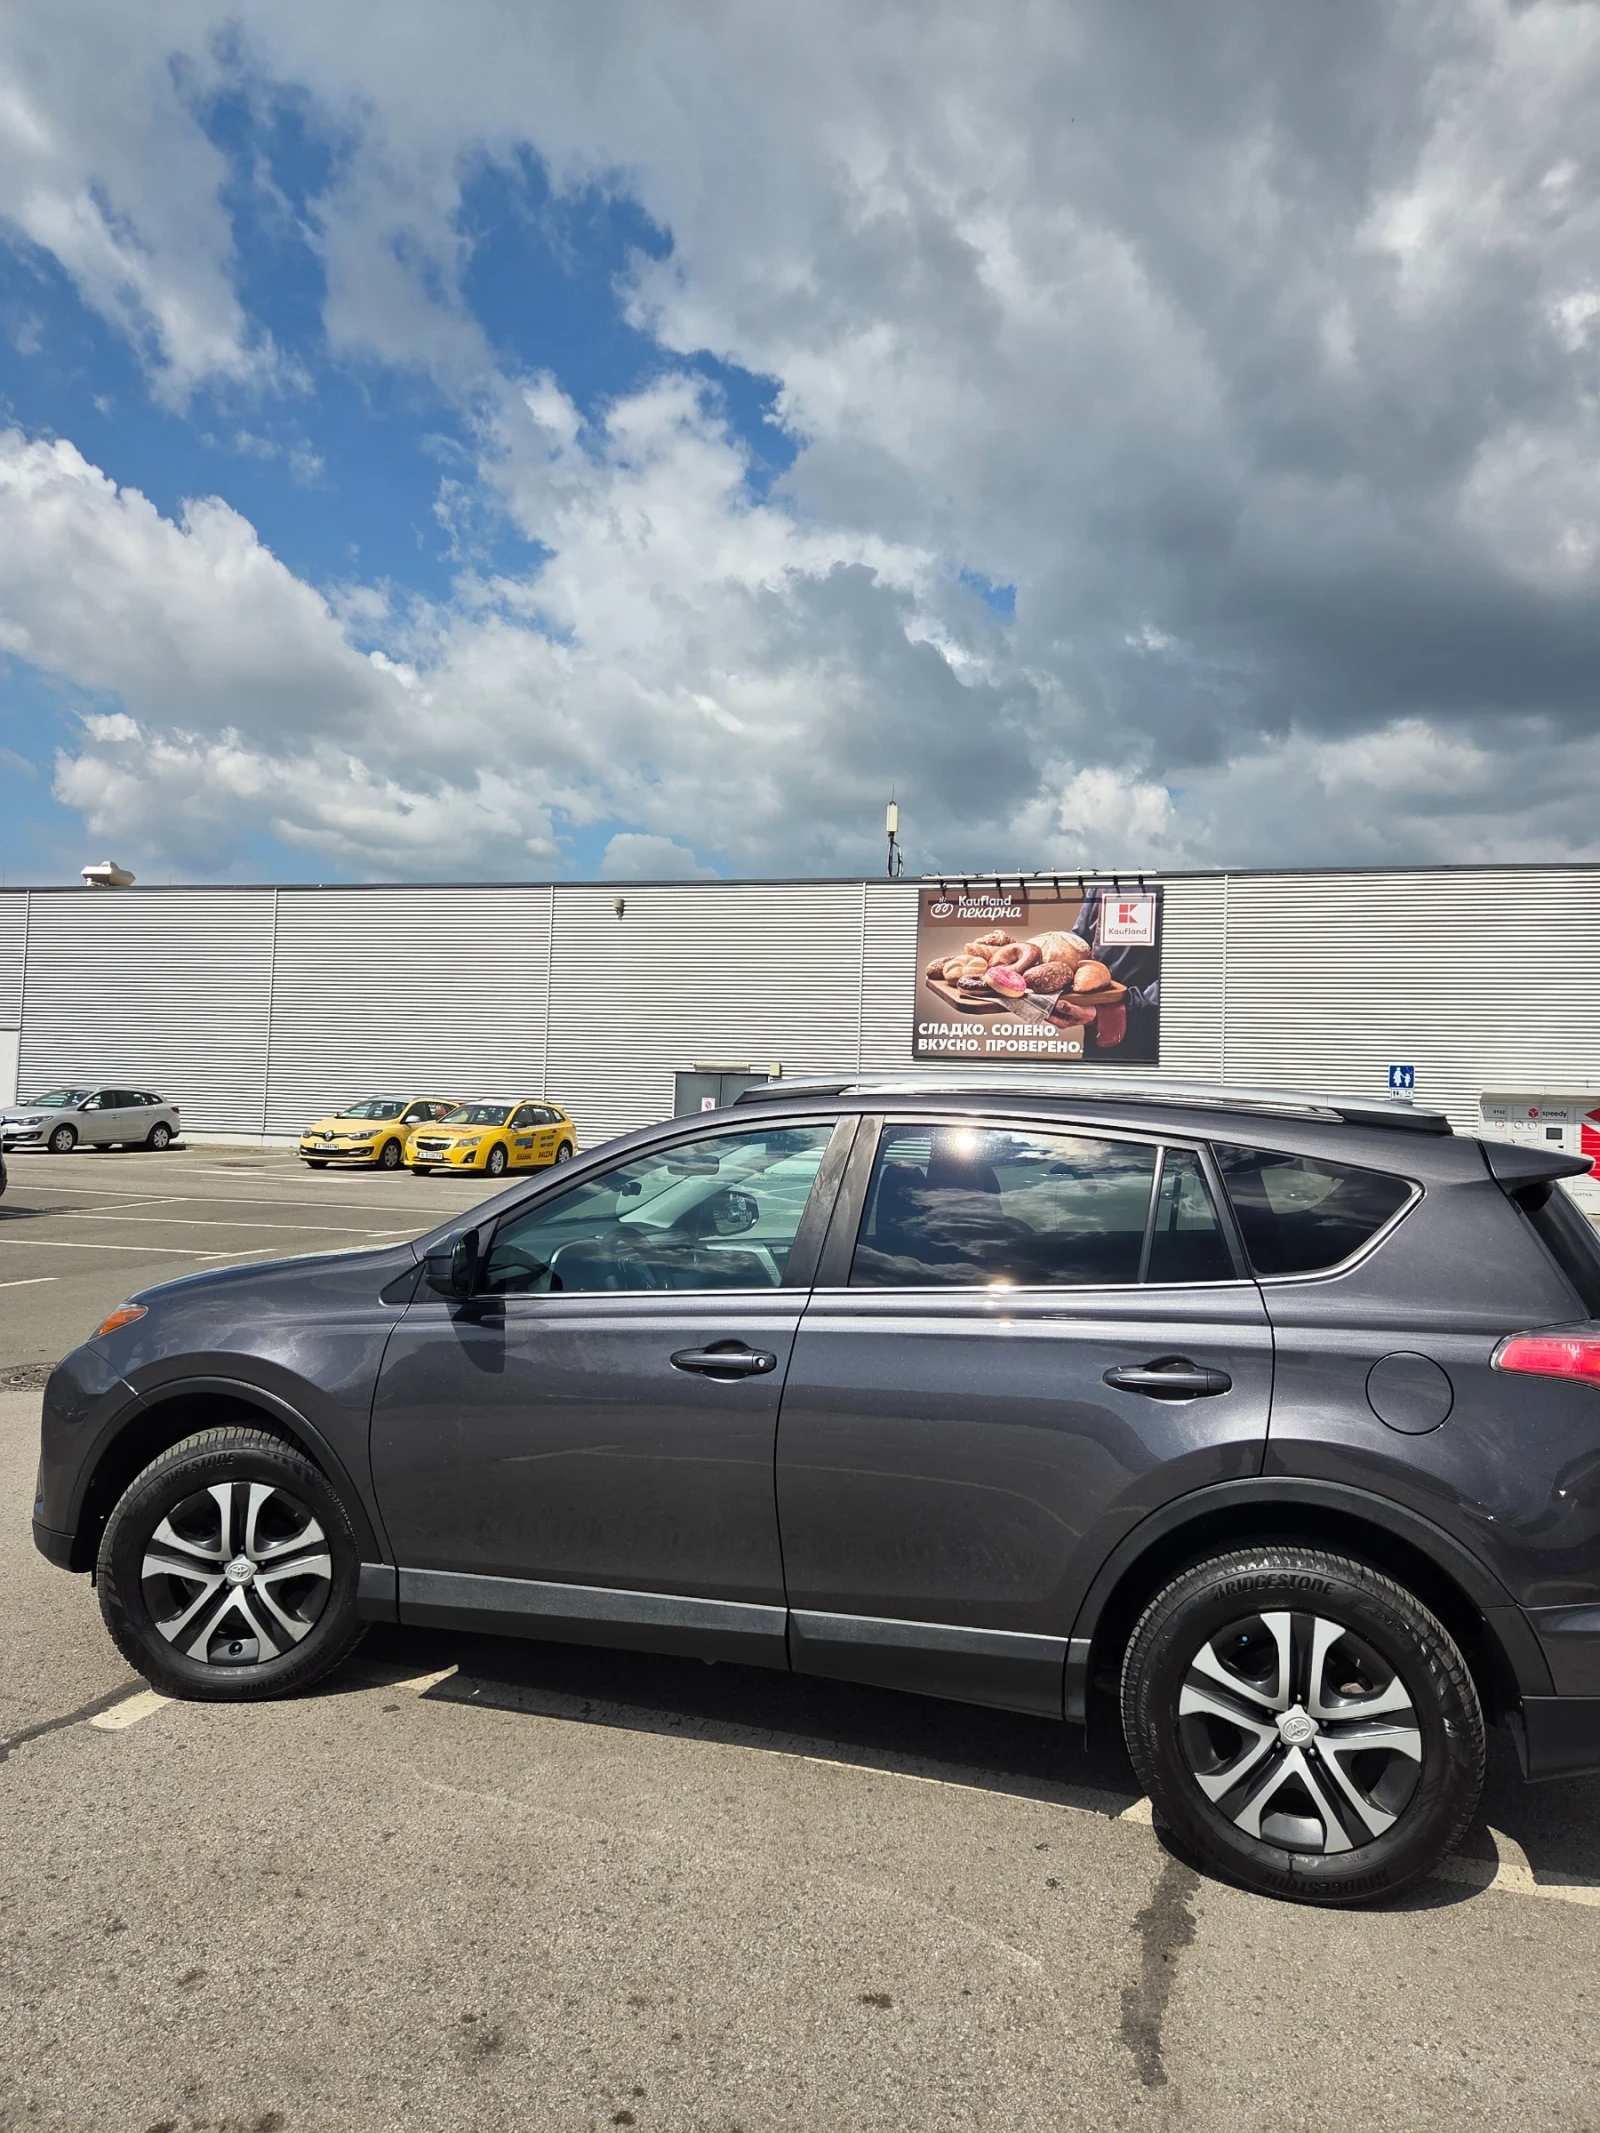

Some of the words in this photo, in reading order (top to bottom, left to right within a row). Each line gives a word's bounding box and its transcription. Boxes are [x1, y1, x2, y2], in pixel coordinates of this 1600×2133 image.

[958, 895, 1012, 906] Kaufland
[957, 905, 1022, 921] пекарна
[1108, 927, 1147, 936] Kaufland
[918, 1023, 987, 1038] СЛАДКО.
[991, 1024, 1060, 1037] СОЛЕНО.
[918, 1038, 982, 1052] ВКУСНО.
[985, 1040, 1084, 1054] ПРОВЕРЕНО.
[1542, 1110, 1567, 1118] speedy
[1214, 1573, 1336, 1602] BRIDGESTONE
